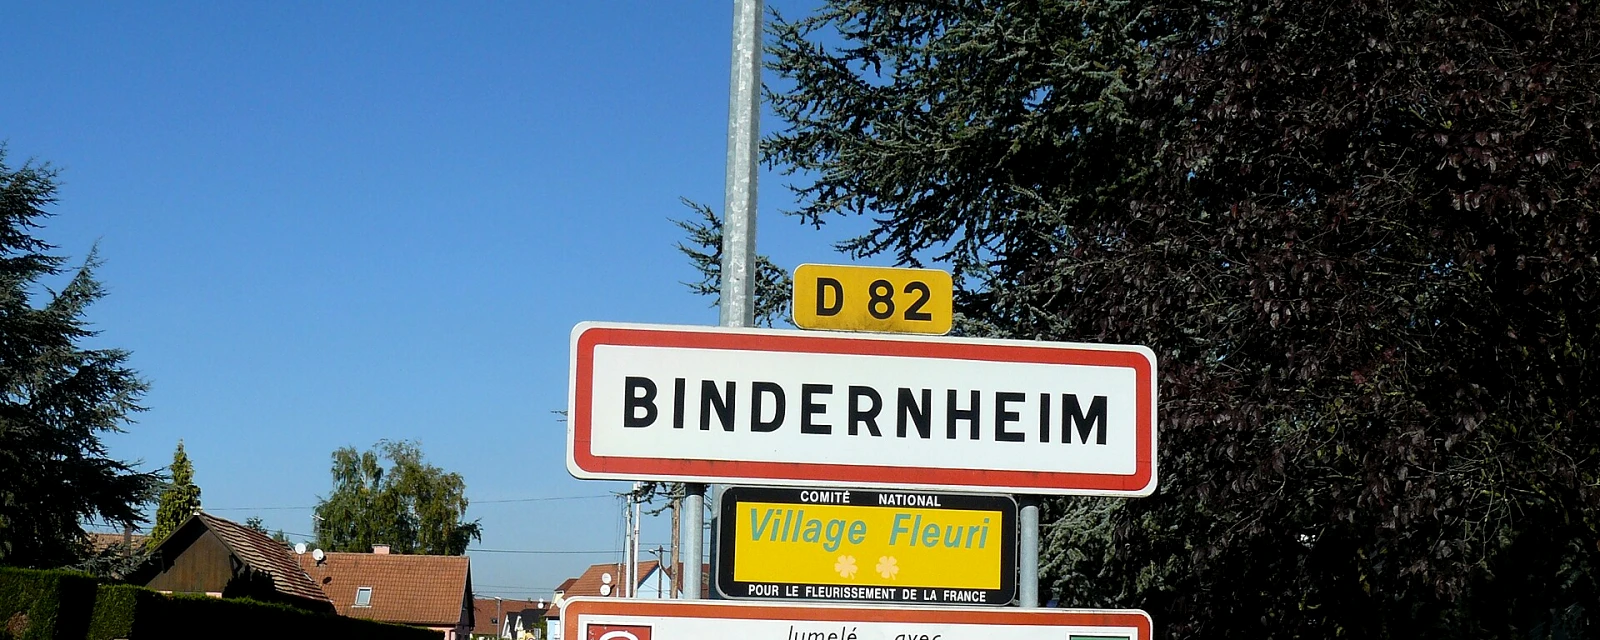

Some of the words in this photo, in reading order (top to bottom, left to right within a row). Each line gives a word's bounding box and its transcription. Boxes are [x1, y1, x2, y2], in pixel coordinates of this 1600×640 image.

[816, 277, 844, 317] D
[867, 279, 932, 322] 82
[623, 376, 1108, 446] BINDERNHEIM
[800, 490, 851, 504] COMITÉ
[878, 493, 942, 507] NATIONAL
[750, 508, 867, 552] Village
[889, 513, 990, 549] Fleuri
[748, 584, 779, 597] POUR
[785, 585, 799, 597] LE
[805, 586, 897, 600] FLEURISSEMENT
[902, 588, 918, 601] DE
[923, 589, 938, 601] LA
[943, 590, 987, 603] FRANCE
